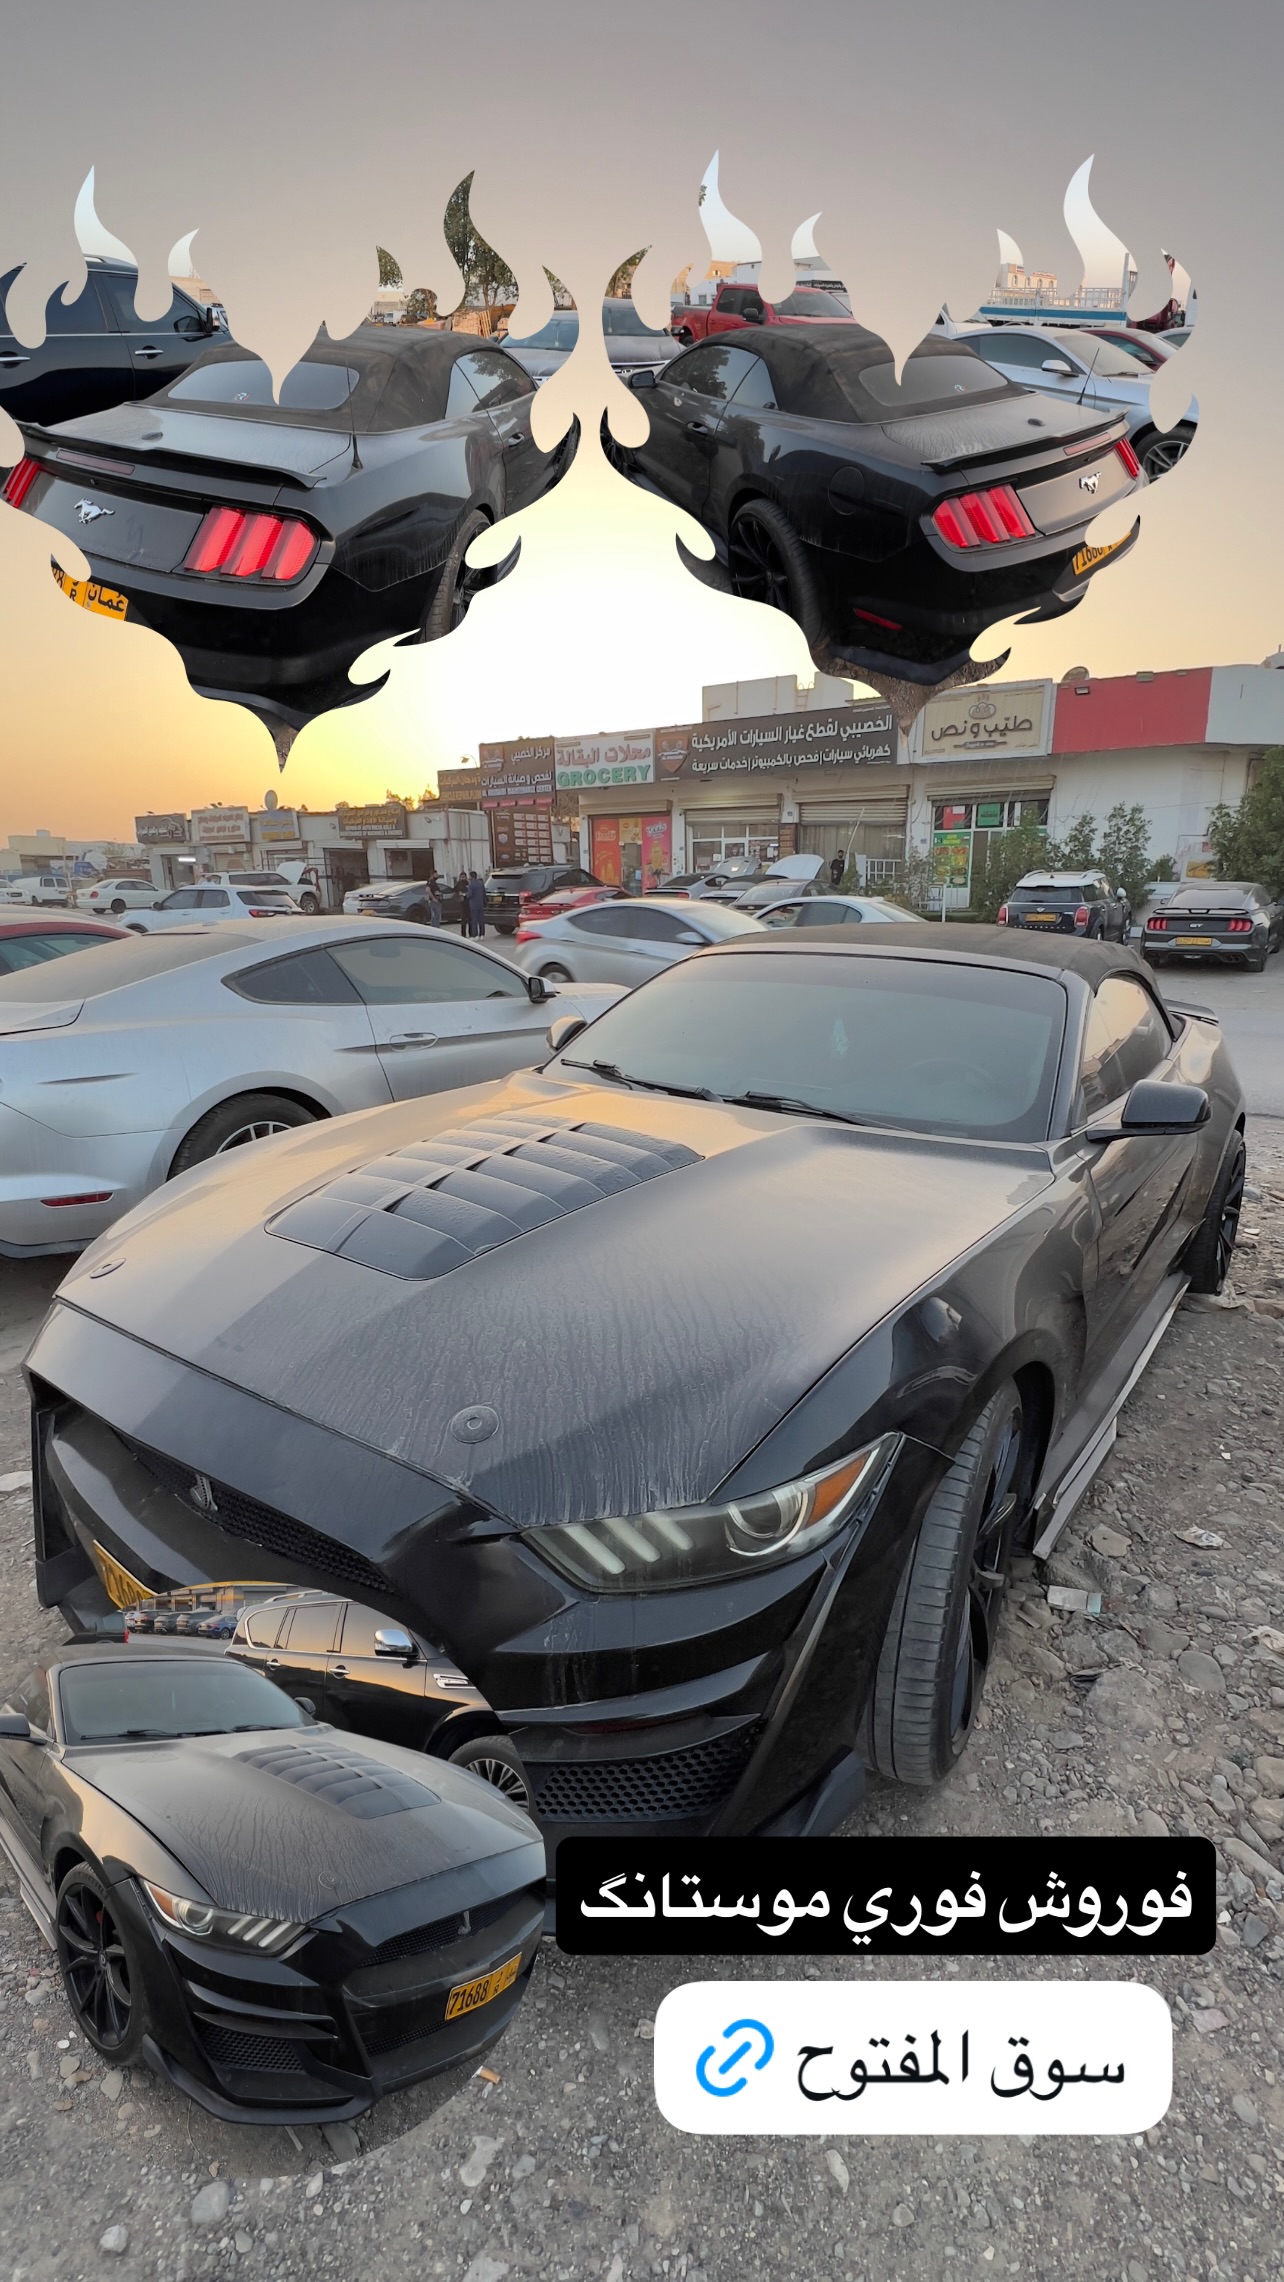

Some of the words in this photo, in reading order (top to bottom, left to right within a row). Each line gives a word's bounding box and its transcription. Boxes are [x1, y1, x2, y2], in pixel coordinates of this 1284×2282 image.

[70, 588, 77, 602] R
[739, 725, 783, 748] السيارات
[784, 722, 805, 744] غيار
[806, 718, 838, 742] لقطع
[842, 714, 893, 742] الخصيبي
[557, 747, 600, 768] البقالة
[604, 743, 651, 764] محلات
[853, 744, 891, 764] كهربائي
[557, 764, 651, 788] GROCERY
[692, 759, 719, 774] سريعة
[449, 1979, 490, 2015] 71688
[494, 1983, 500, 1993] R
